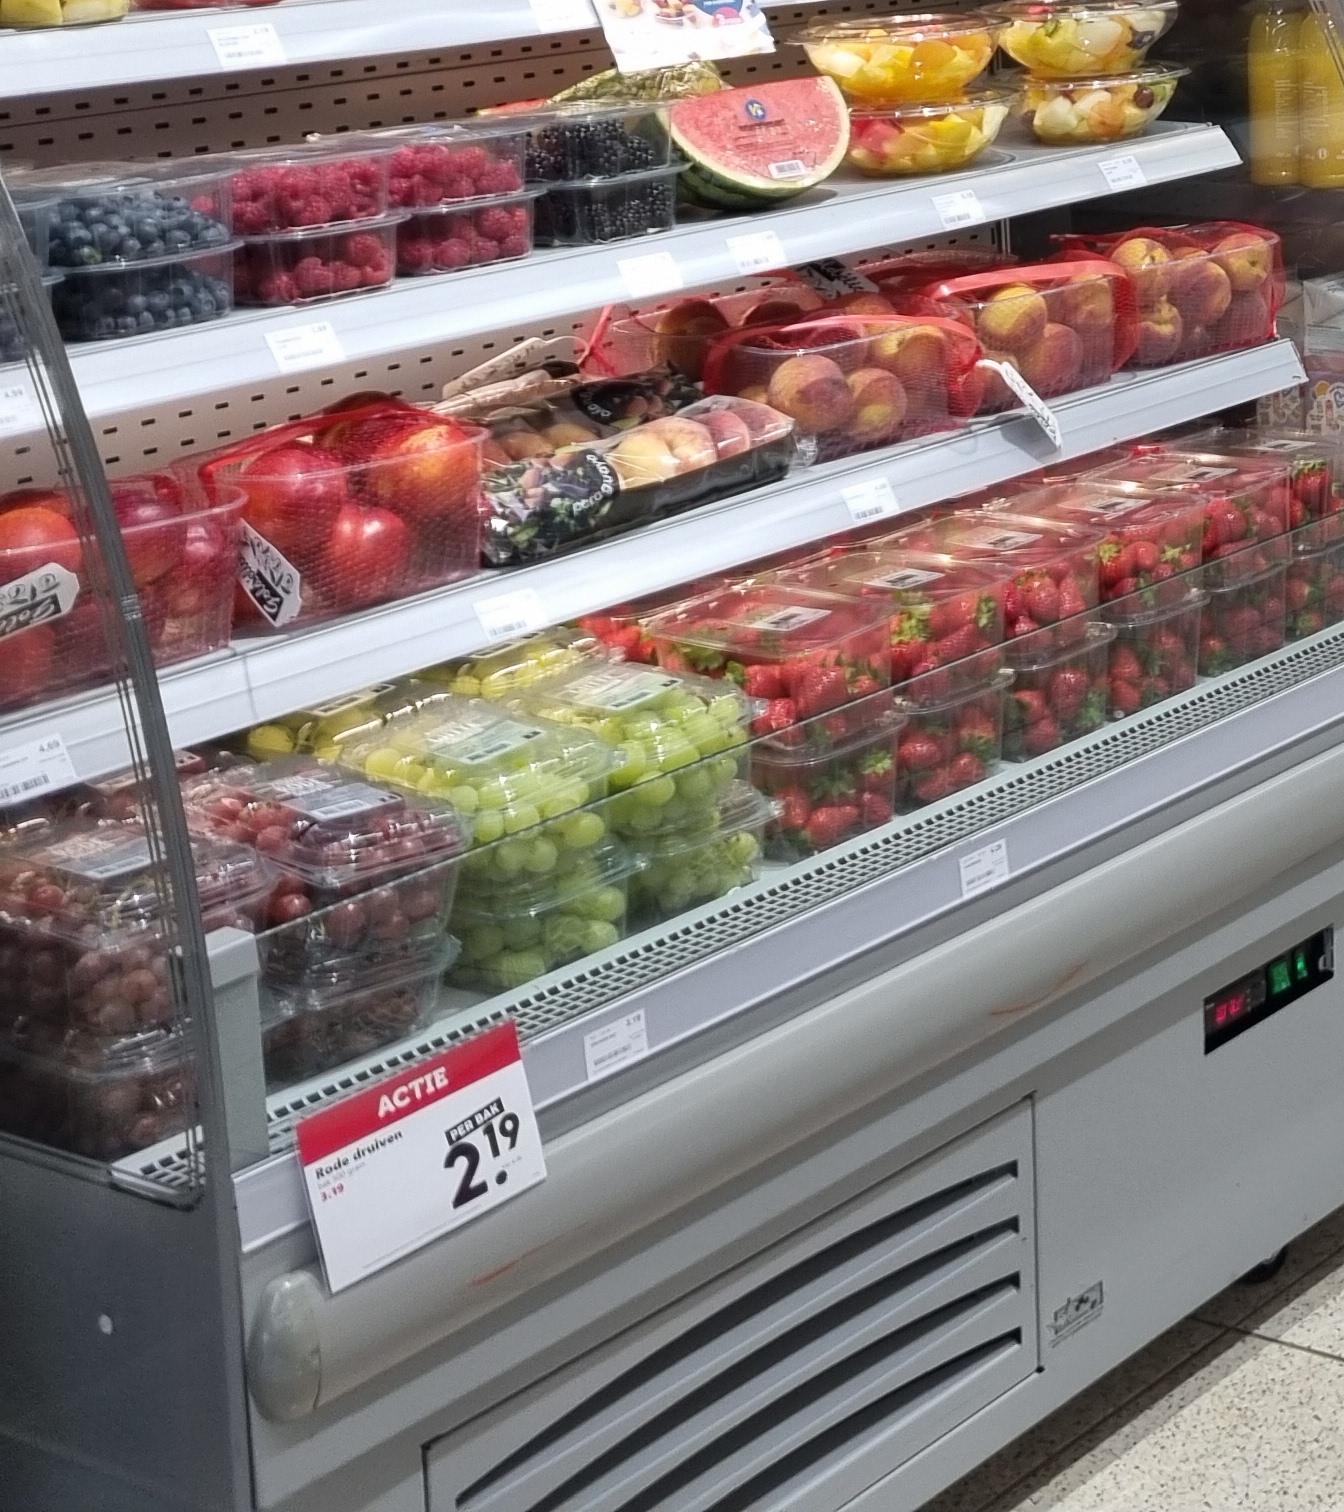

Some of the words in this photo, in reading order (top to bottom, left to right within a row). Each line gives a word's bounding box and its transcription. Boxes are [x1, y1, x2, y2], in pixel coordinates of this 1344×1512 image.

[377, 1066, 449, 1118] ACTIE
[315, 1156, 350, 1180] Rode
[352, 1130, 403, 1168] druiven
